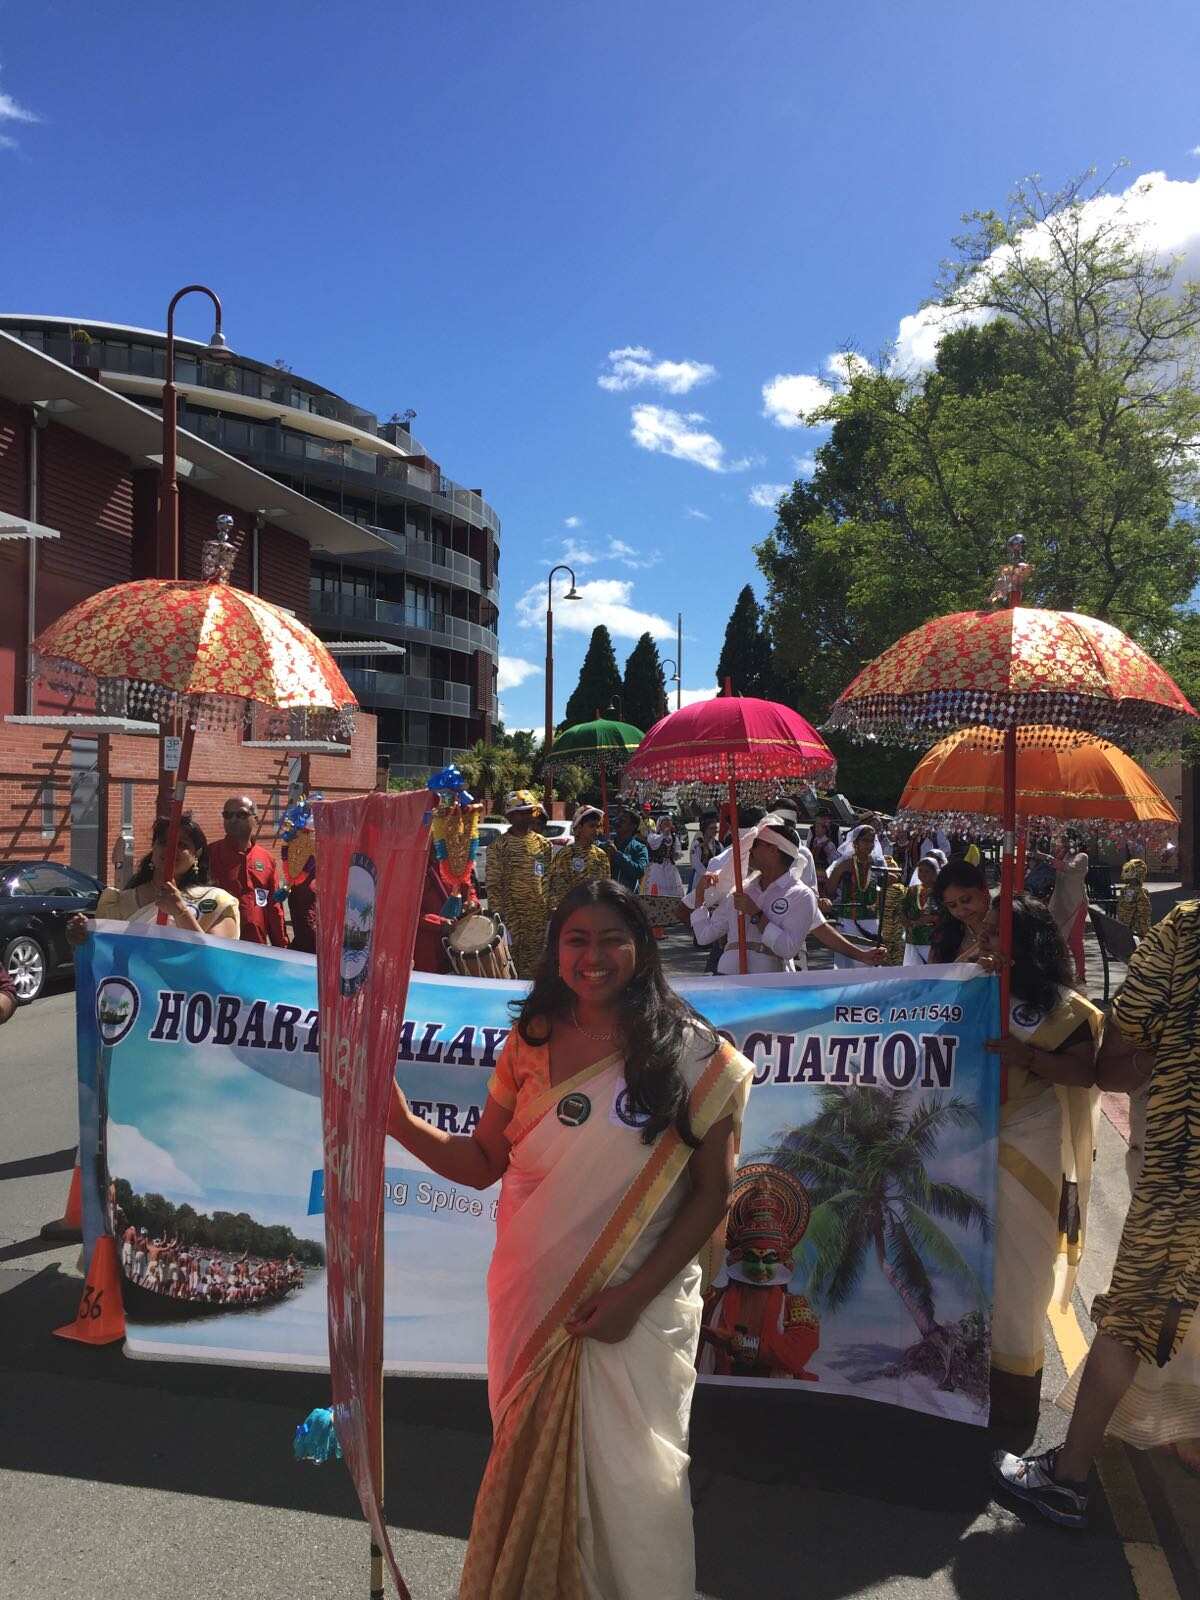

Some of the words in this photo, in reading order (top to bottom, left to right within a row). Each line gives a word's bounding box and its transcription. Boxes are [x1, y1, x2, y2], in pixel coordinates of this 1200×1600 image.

[150, 992, 320, 1052] HOBART
[397, 1021, 510, 1067] ALAY
[835, 1006, 884, 1024] REG.
[889, 1005, 963, 1023] IA11549
[717, 1031, 957, 1088] CIATION
[406, 1099, 481, 1134] ERA
[416, 1182, 483, 1217] Spice
[490, 1199, 499, 1222] t
[80, 1284, 105, 1320] 36
